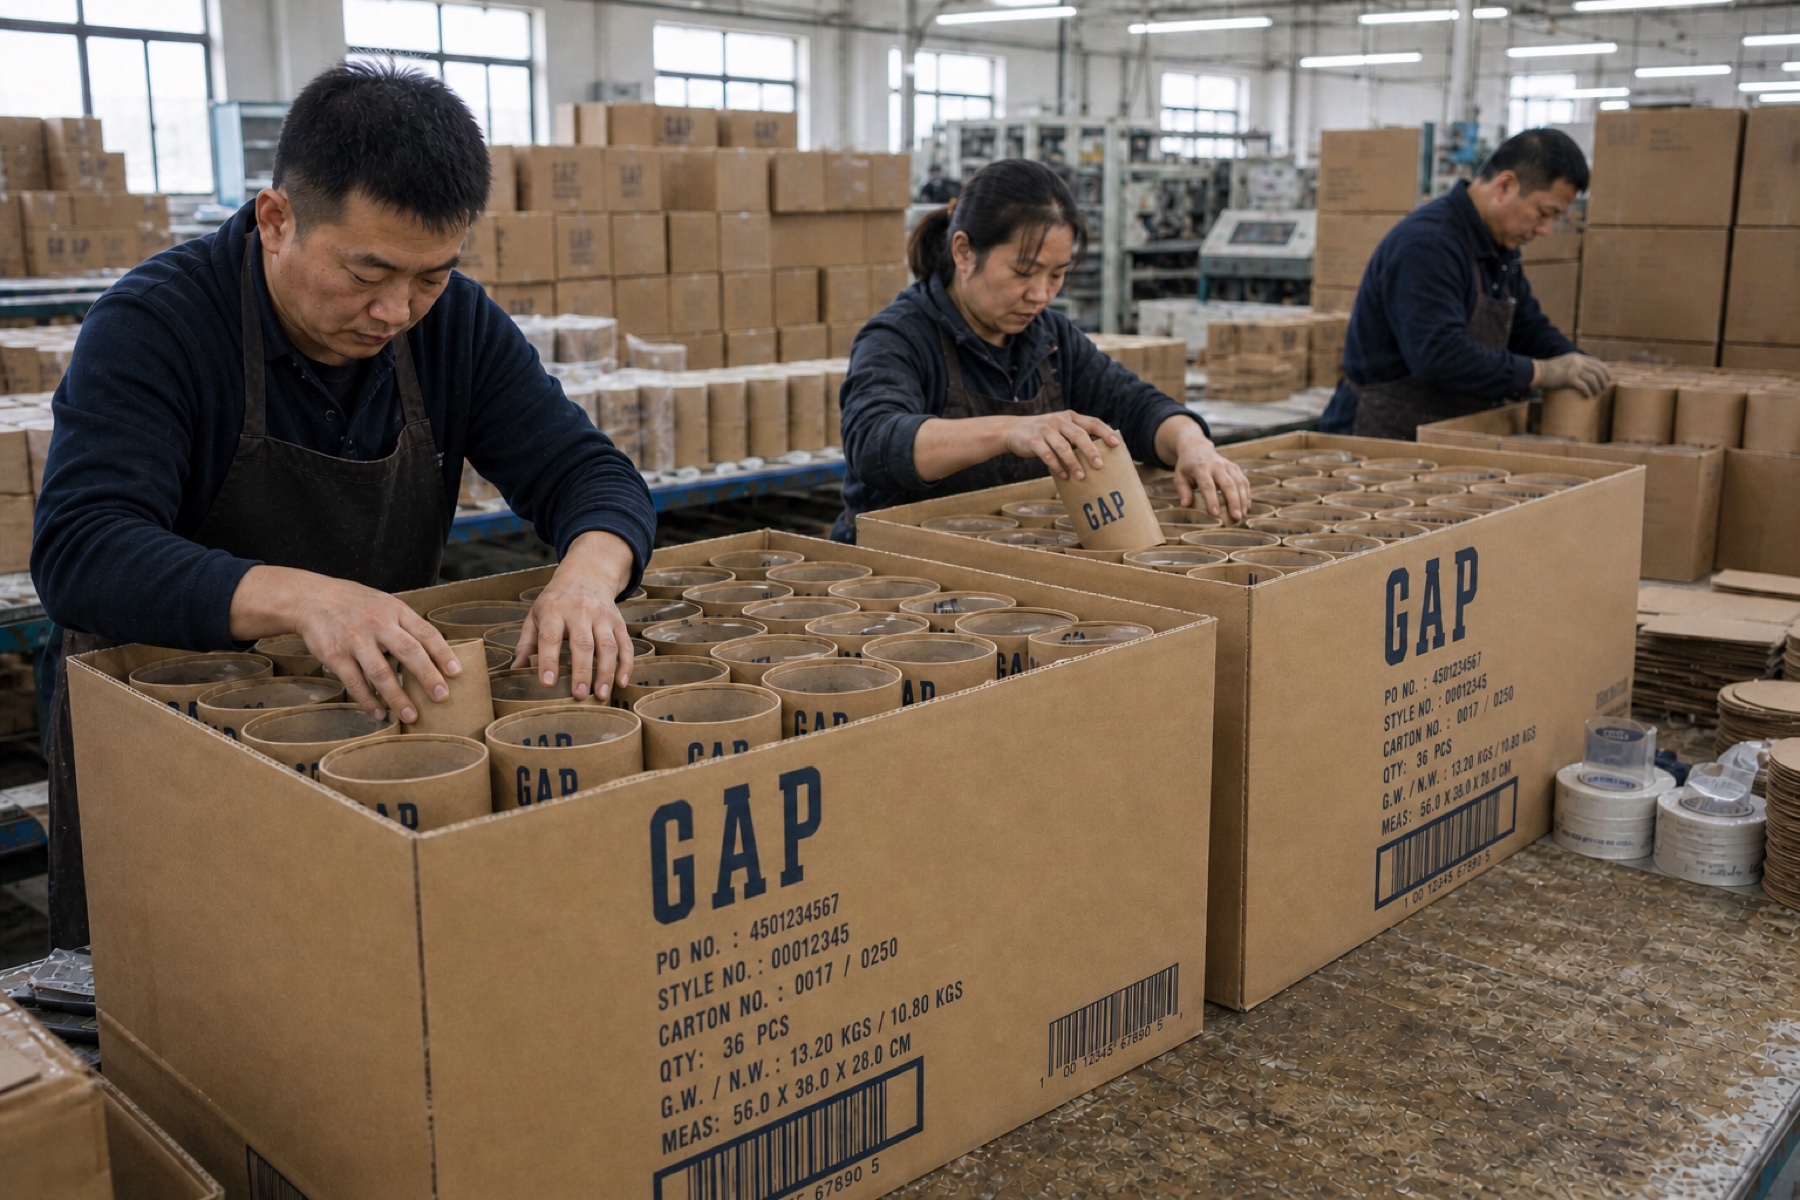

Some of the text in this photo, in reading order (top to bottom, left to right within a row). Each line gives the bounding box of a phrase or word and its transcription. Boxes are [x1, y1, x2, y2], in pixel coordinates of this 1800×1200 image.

[1083, 491, 1124, 530] GAP
[1385, 546, 1478, 666] GAP
[1384, 705, 1415, 732] STYLE
[1418, 698, 1434, 718] NO.
[1445, 673, 1487, 704] 00012345
[1385, 687, 1397, 706] PO
[1402, 679, 1418, 699] NO.
[1432, 651, 1481, 685] 4501234567
[1383, 727, 1422, 757] CARTON
[1426, 719, 1442, 739] NO.
[1457, 702, 1478, 724] 0017
[1383, 738, 1452, 784] QTY: 36 PCS
[1381, 810, 1412, 836] MEAS:
[1420, 794, 1440, 817] 56.0
[1444, 789, 1451, 806] X
[1382, 786, 1406, 810] G.W.
[1409, 780, 1415, 798] /
[1418, 770, 1440, 794] N.W.
[650, 766, 822, 926] GAP
[656, 948, 680, 975] PO
[690, 936, 720, 963] NO.
[750, 893, 839, 941] 4501234567
[658, 972, 714, 1011] STYLE
[722, 961, 752, 988] NO.
[771, 922, 850, 969] 00012345
[659, 1001, 730, 1047] CARTON
[740, 990, 768, 1017] NO.
[795, 962, 833, 995] 0017
[844, 954, 851, 977] /
[861, 937, 898, 969] 0250
[660, 1015, 790, 1083] QTY: 36 PCS
[661, 1085, 703, 1119] G.W.
[713, 1076, 721, 1100] /
[729, 1060, 770, 1093] N.W.
[790, 1034, 833, 1067] 13.20
[841, 1017, 872, 1047] KGS
[878, 1011, 885, 1034] /
[891, 994, 929, 1026] 10.80
[936, 981, 963, 1009] KGS
[1040, 1019, 1163, 1088] 1 00 12345 67890 5
[662, 1033, 912, 1155] MEAS: 56.0 X 38.0 X 28.0 CM
[815, 1157, 879, 1200] 67890 5
